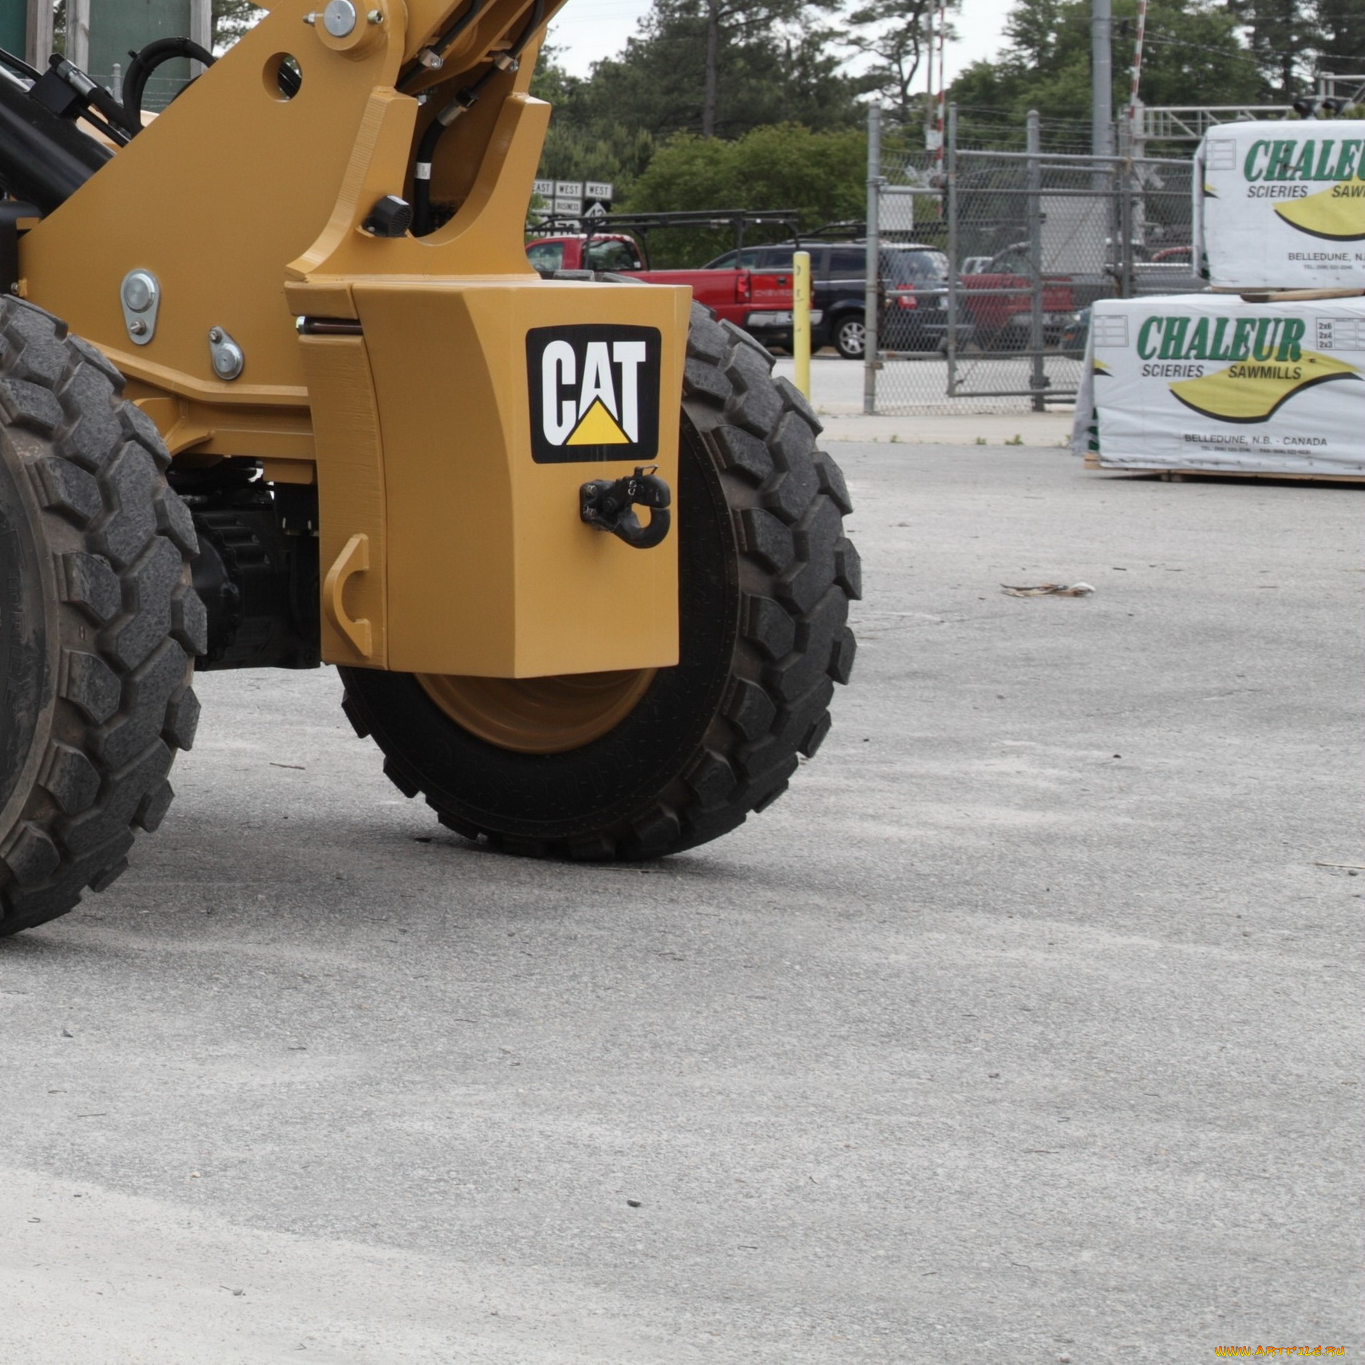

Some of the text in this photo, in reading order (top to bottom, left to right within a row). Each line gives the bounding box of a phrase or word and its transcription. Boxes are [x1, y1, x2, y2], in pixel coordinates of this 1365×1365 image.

[559, 185, 579, 194] WEST
[589, 187, 608, 195] WEST
[1247, 185, 1308, 198] SCIERIES
[557, 202, 579, 211] BUSINESS
[1288, 253, 1351, 263] BELLEDUNE,
[1136, 315, 1306, 363] CHALEUR
[1142, 364, 1302, 380] SCIERIES SAWMILLS
[542, 340, 646, 446] CAT
[1185, 434, 1328, 447] BELLEDUNE, N.B. CANADA
